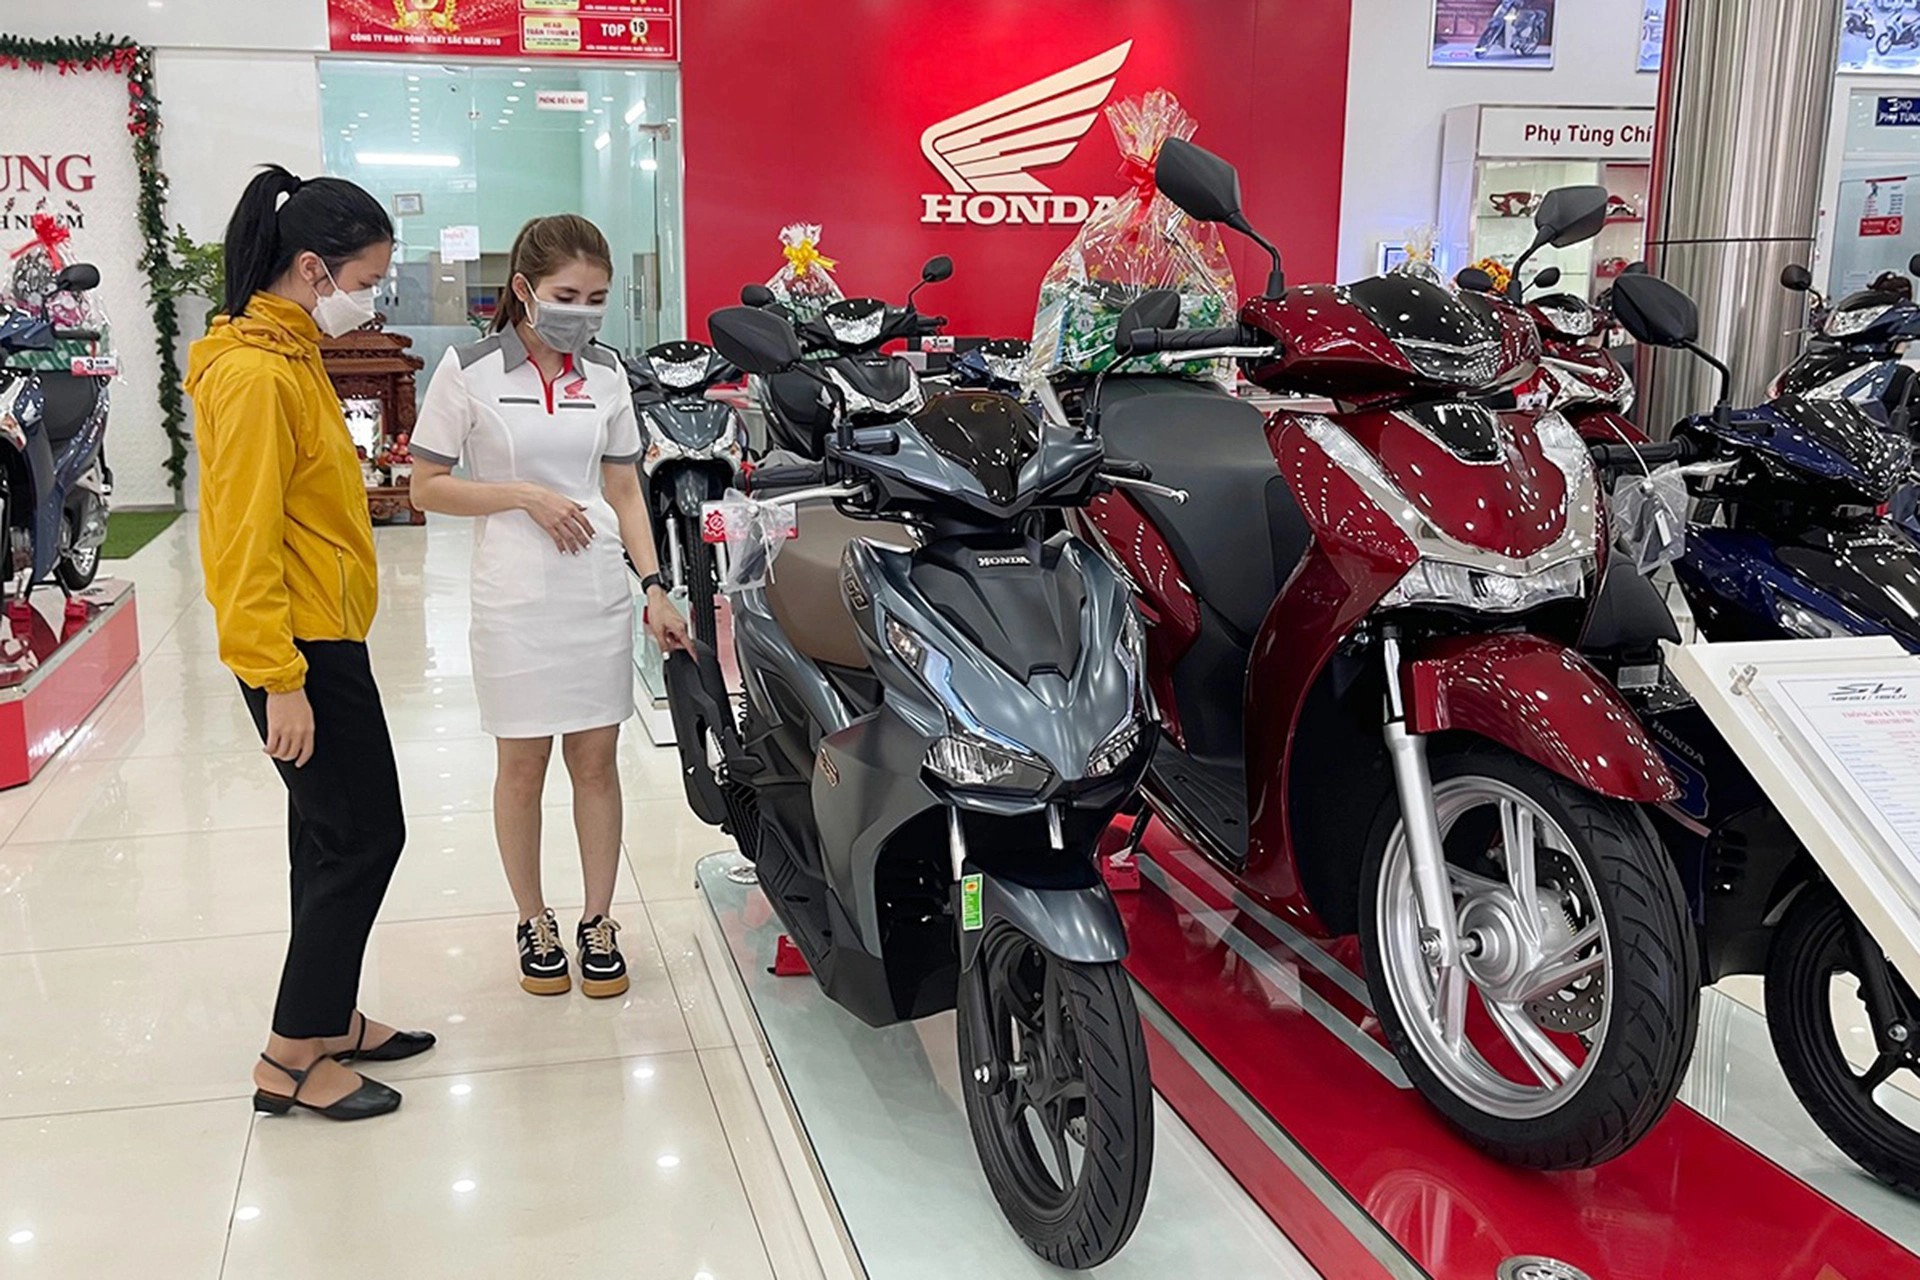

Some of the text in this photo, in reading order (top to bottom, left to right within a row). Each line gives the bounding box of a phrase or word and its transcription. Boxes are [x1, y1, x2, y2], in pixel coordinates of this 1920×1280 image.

[600, 21, 645, 37] TOP 19
[373, 34, 382, 42] TY
[1524, 124, 1561, 146] Phụ
[1567, 124, 1615, 147] Tùng
[920, 194, 1118, 225] HONDA
[86, 358, 94, 371] 3
[977, 556, 1031, 567] HONDA
[1651, 719, 1706, 767] HONDA
